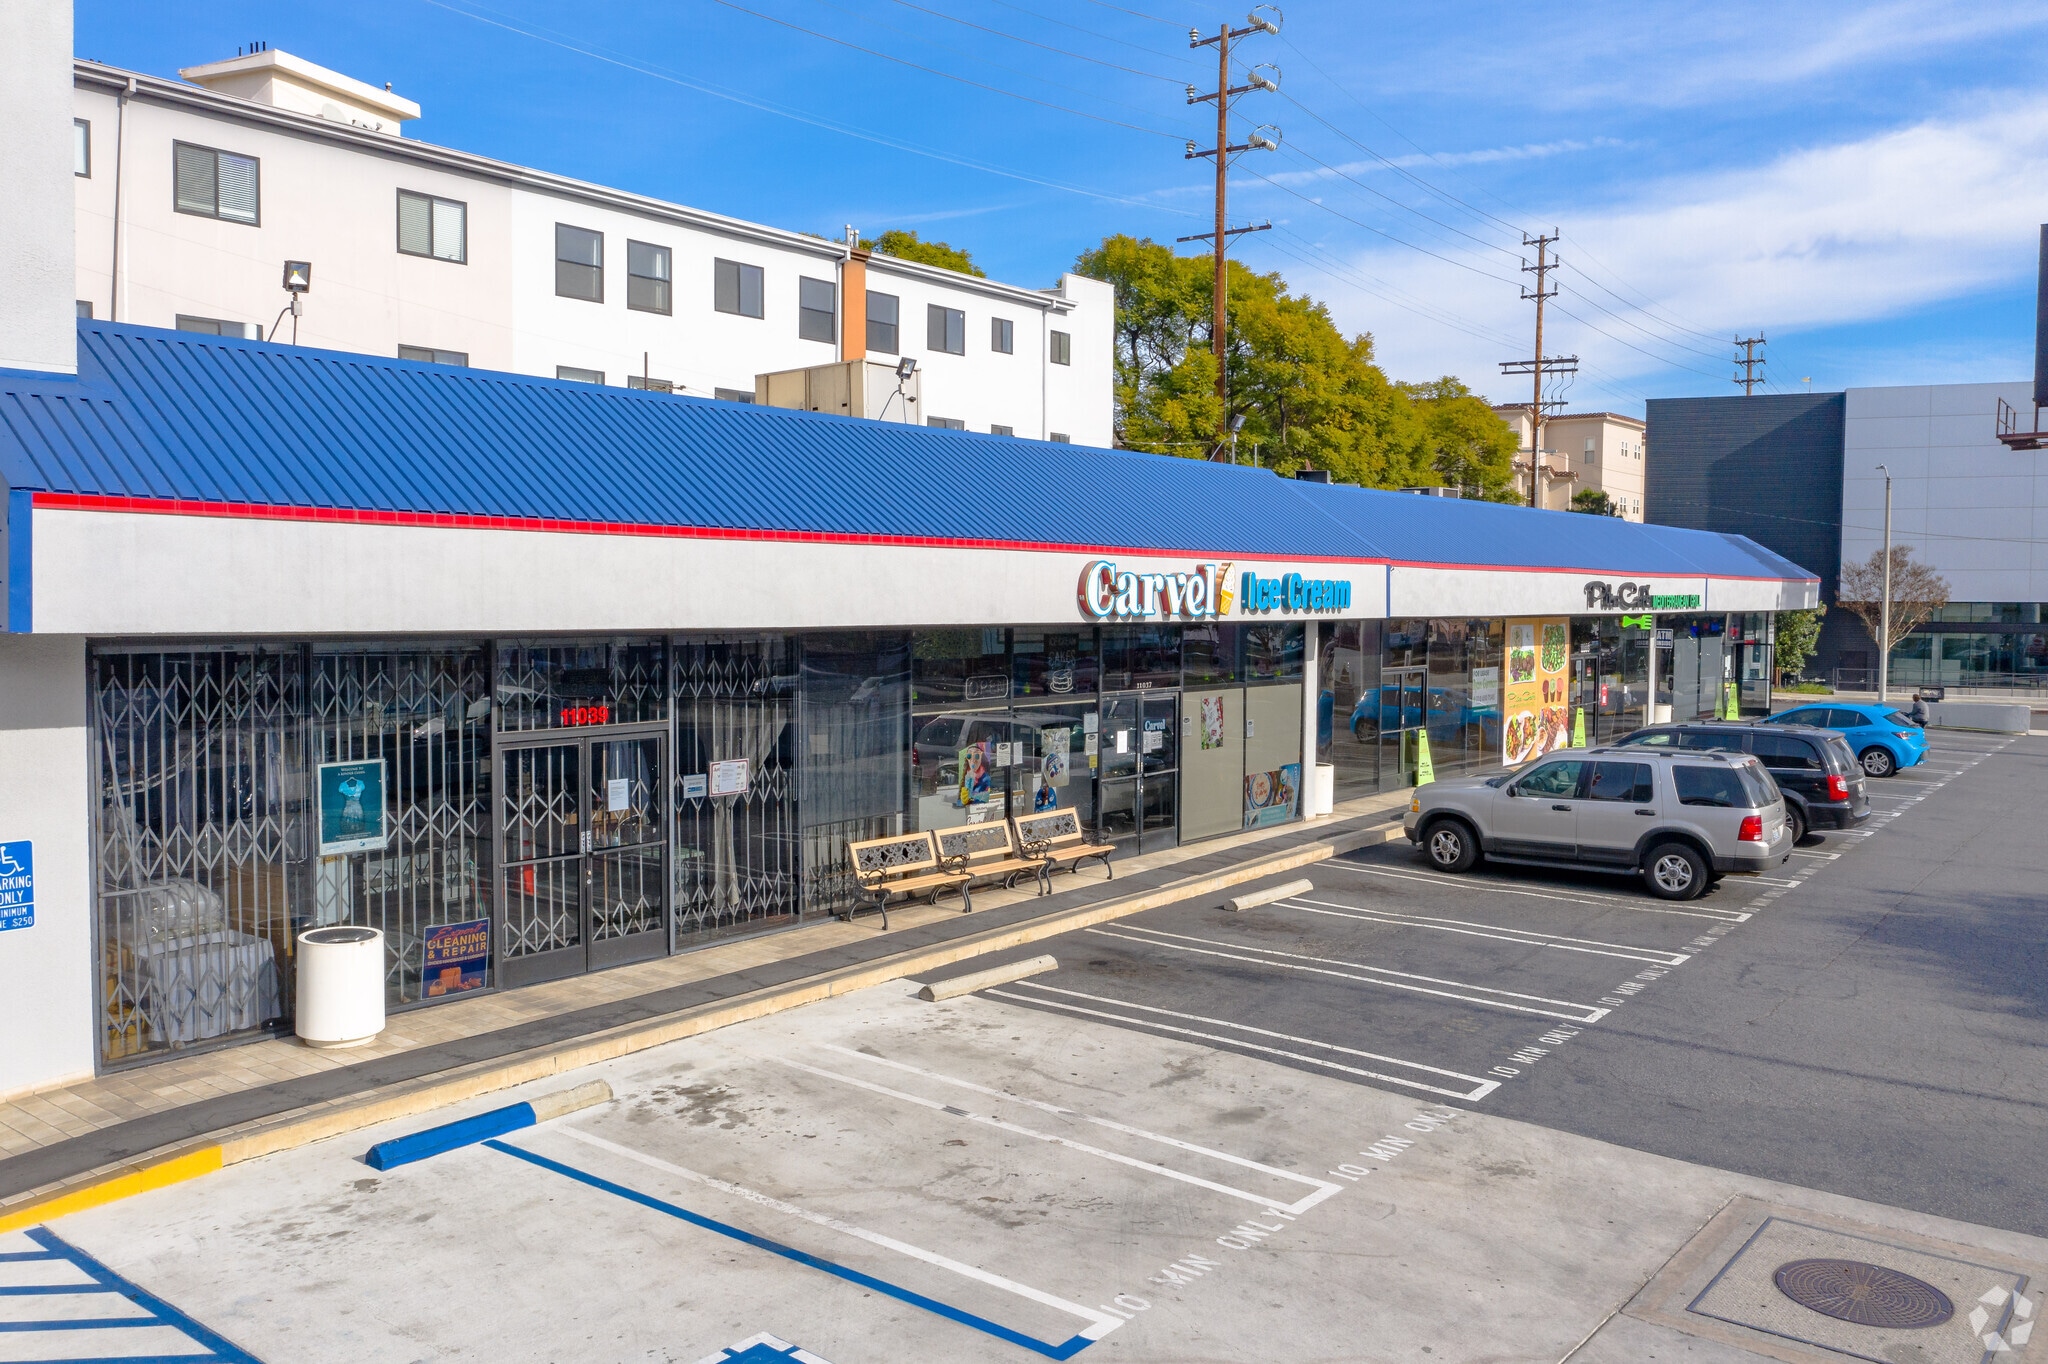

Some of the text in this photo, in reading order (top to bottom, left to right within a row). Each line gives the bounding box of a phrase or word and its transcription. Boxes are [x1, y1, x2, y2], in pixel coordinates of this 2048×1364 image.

[1078, 560, 1352, 617] Carvel Ice Cream
[969, 680, 1005, 697] OPEN
[561, 706, 609, 726] 11039
[1144, 718, 1166, 731] Carvel
[12, 916, 33, 927] $250
[427, 932, 486, 950] CLEANING
[427, 943, 486, 959] & REPAIR
[1596, 964, 1673, 1007] 10 MIN ONLY
[1487, 1023, 1584, 1079] 10 MIN ONLY
[1327, 1163, 1370, 1182] 10
[1359, 1134, 1415, 1162] MIN
[1100, 1207, 1296, 1319] 10 MIN ONLY
